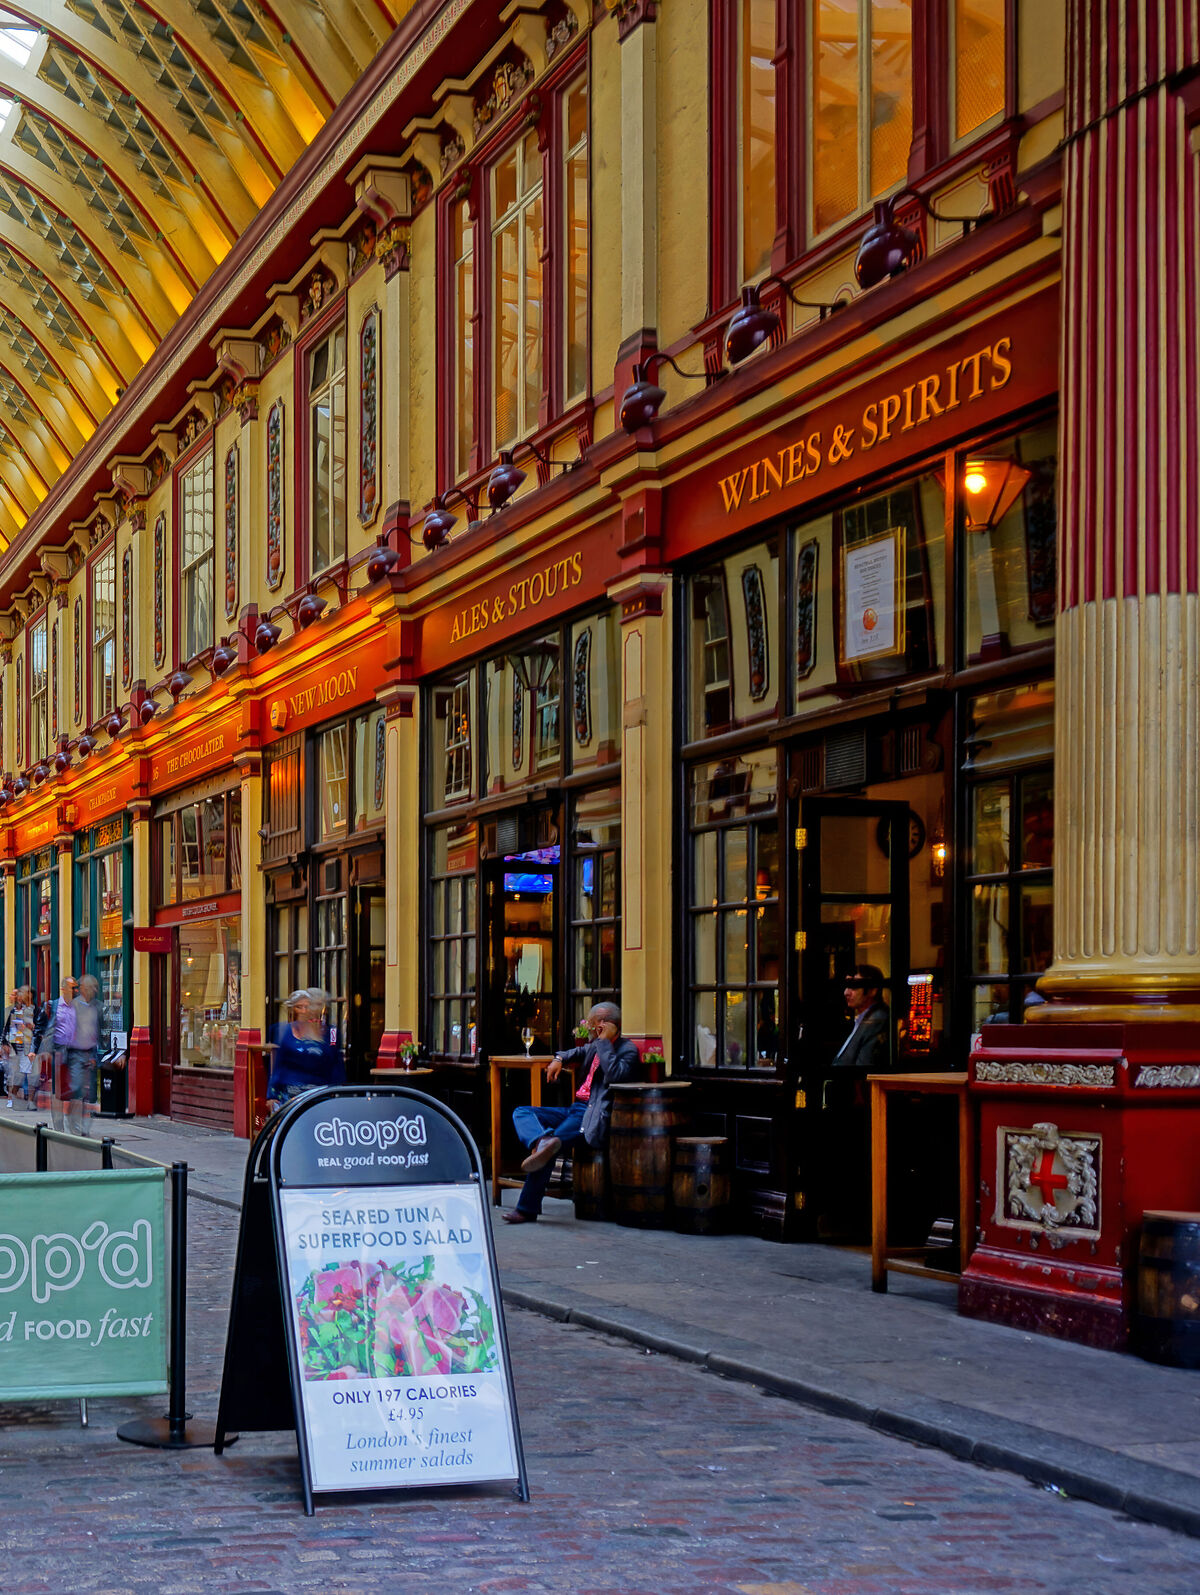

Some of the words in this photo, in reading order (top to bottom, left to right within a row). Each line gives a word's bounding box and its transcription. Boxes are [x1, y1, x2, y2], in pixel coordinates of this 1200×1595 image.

[717, 431, 823, 513] WINES
[828, 424, 855, 466] &
[860, 337, 1012, 450] SPIRITS
[450, 600, 489, 644] ALES
[492, 596, 506, 623] &
[508, 552, 582, 616] STOUTS
[289, 686, 317, 718] NEW
[317, 666, 358, 707] MOON
[167, 756, 179, 773] THE
[180, 735, 224, 768] CHOCOLATIER
[314, 1115, 427, 1150] chop'd
[317, 1156, 342, 1167] REAL
[343, 1153, 374, 1169] good
[377, 1155, 405, 1165] FOOD
[405, 1151, 429, 1168] fast
[322, 1209, 390, 1226] SEARED
[395, 1207, 444, 1223] TUNA
[298, 1231, 407, 1249] SUPERFOOD
[412, 1229, 473, 1245] SALAD
[24, 1319, 91, 1340] FOOD
[90, 1308, 153, 1346] fast
[332, 1390, 371, 1404] ONLY
[378, 1389, 401, 1402] 197
[406, 1385, 477, 1400] CALORIES
[388, 1407, 424, 1421] £4.95
[425, 1427, 473, 1449] finest
[350, 1457, 416, 1472] summer
[420, 1449, 473, 1468] salads
